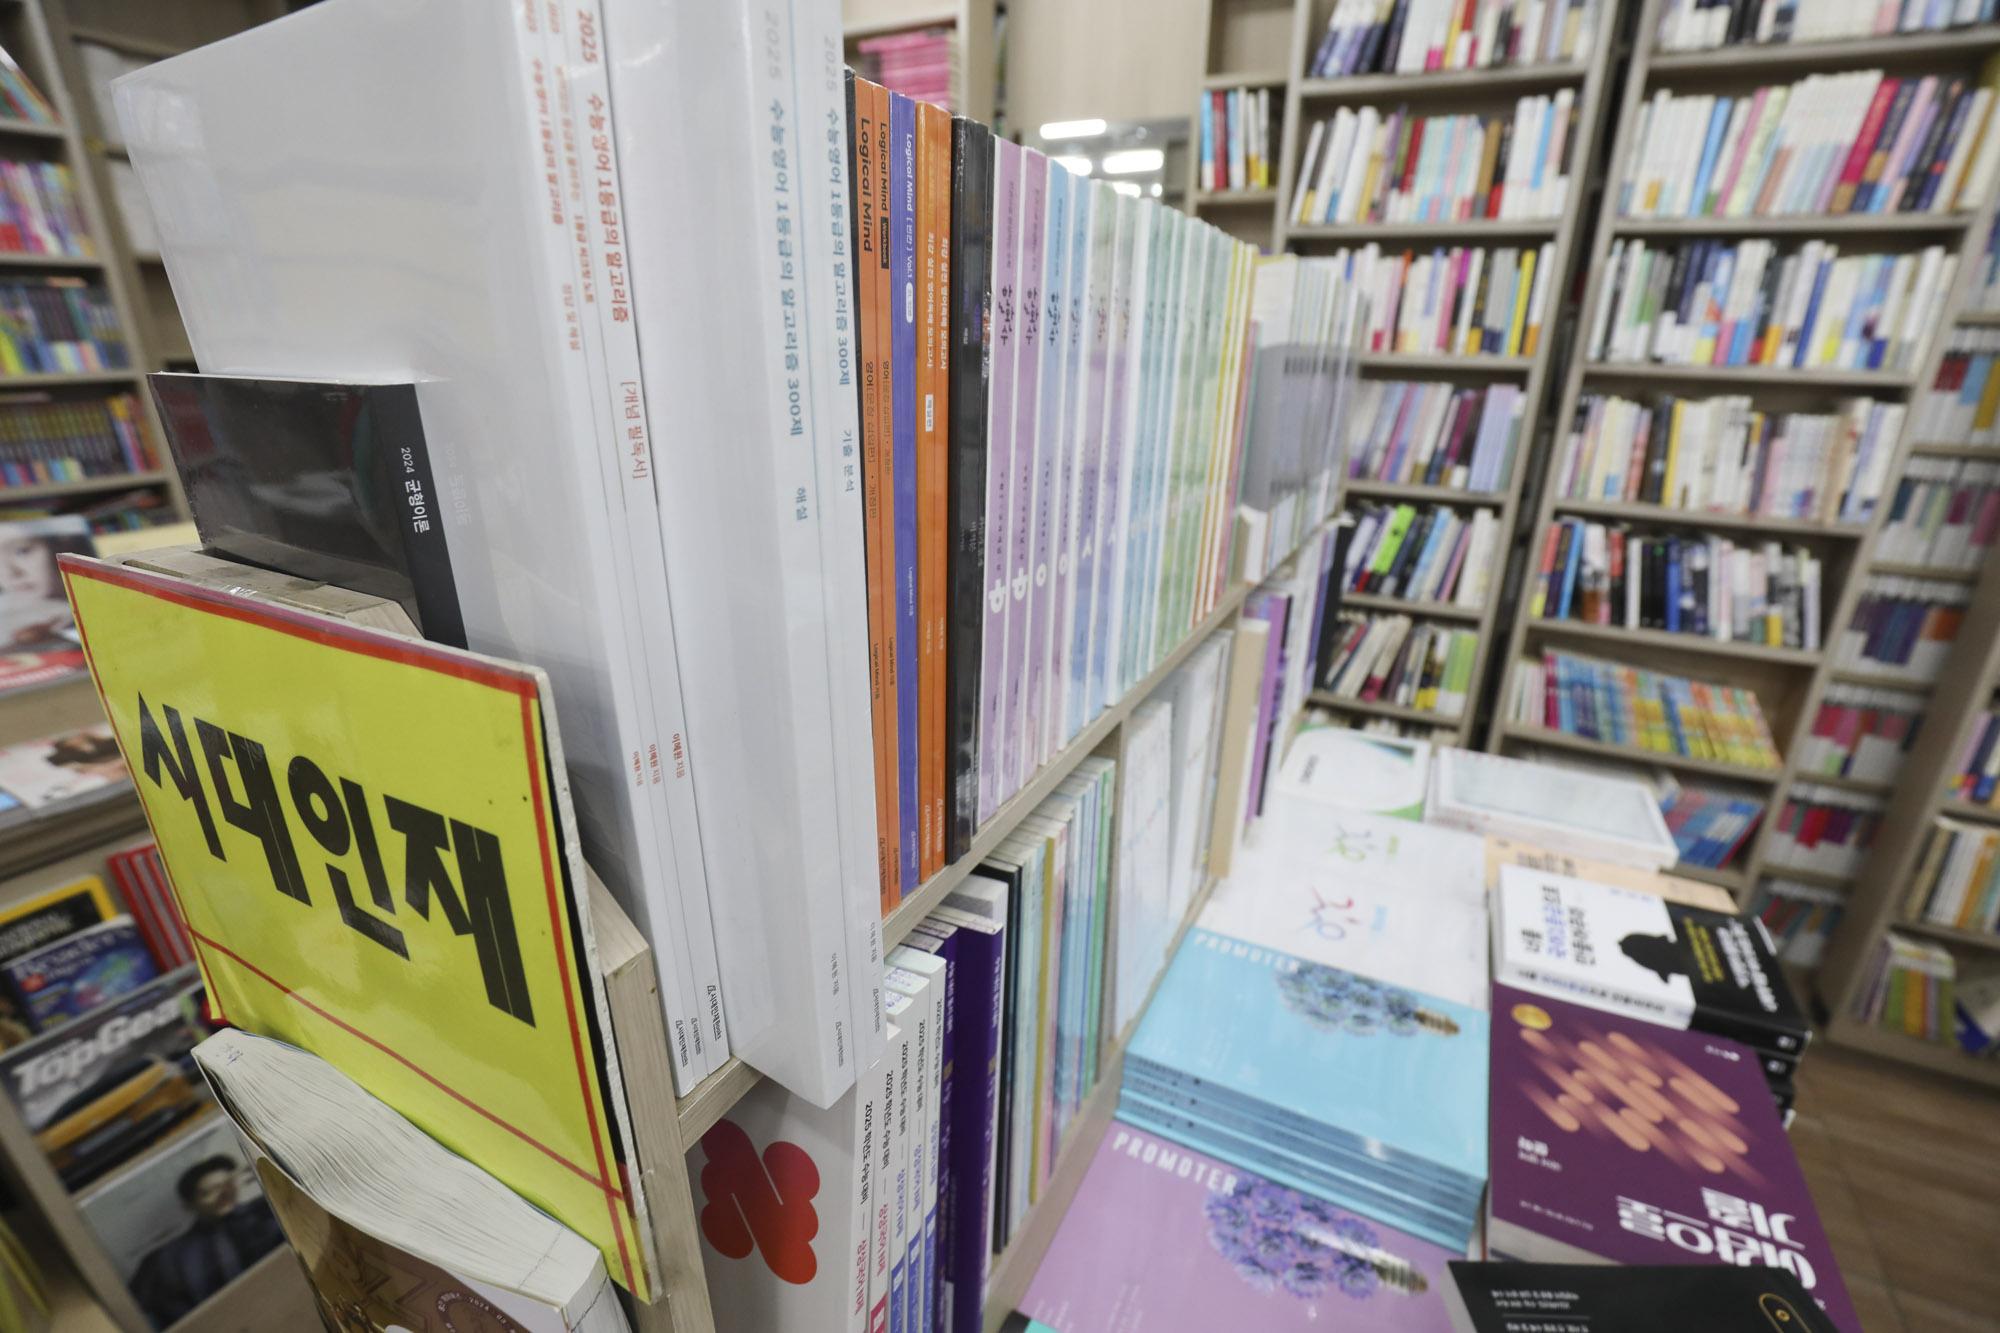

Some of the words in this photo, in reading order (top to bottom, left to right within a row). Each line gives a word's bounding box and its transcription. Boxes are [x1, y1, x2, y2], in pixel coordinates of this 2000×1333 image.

[577, 9, 598, 65] 2025
[587, 93, 612, 172] 수능영어
[769, 97, 790, 194] 수능영어
[826, 107, 842, 185] 수능영어
[879, 121, 888, 171] Logical
[859, 117, 874, 199] Logical
[905, 132, 913, 178] Logical
[598, 178, 620, 246] 1등급의
[880, 174, 888, 213] Mind
[776, 203, 795, 281] 1등급의
[831, 191, 846, 256] 1등급의
[862, 203, 873, 254] Mind
[881, 220, 889, 265] Workbook
[927, 231, 935, 255] 최강
[927, 257, 935, 279] 실전
[941, 236, 948, 259] 최강
[605, 250, 629, 323] 알고리즘
[941, 261, 948, 283] 실전
[834, 260, 848, 331] 알고리즘
[940, 286, 948, 327] 영어독해
[780, 288, 799, 372] 알고리즘
[926, 327, 934, 368] 모의고사
[838, 336, 851, 386] 300제
[788, 378, 804, 436] 300제
[401, 447, 415, 474] 2024
[405, 479, 430, 533] 균형이론
[796, 486, 808, 521] 해설
[675, 760, 686, 779] 지음
[138, 691, 536, 1028] 시대인재
[1194, 933, 1300, 975] PROMOTER
[709, 993, 722, 1042] 시대인재Books
[917, 1018, 926, 1045] 2025
[13, 998, 182, 1097] TopGea
[901, 1040, 909, 1069] 2025
[916, 1046, 925, 1072] 학년도
[884, 1069, 894, 1100] 2025
[900, 1069, 908, 1098] 학년도
[914, 1091, 922, 1112] 대비
[916, 1073, 923, 1090] 수능
[863, 1100, 873, 1131] 2025
[883, 1100, 893, 1130] 학년도
[897, 1115, 906, 1136] 대비
[899, 1098, 906, 1115] 수능
[862, 1131, 872, 1162] 학년도
[881, 1150, 890, 1171] 대비
[883, 1130, 890, 1150] 수능
[861, 1162, 870, 1183] 수능
[1112, 1131, 1238, 1198] PROMOTER
[858, 1183, 868, 1206] 대비
[877, 1203, 889, 1252] 상상국어
[855, 1238, 868, 1291] 상상국어
